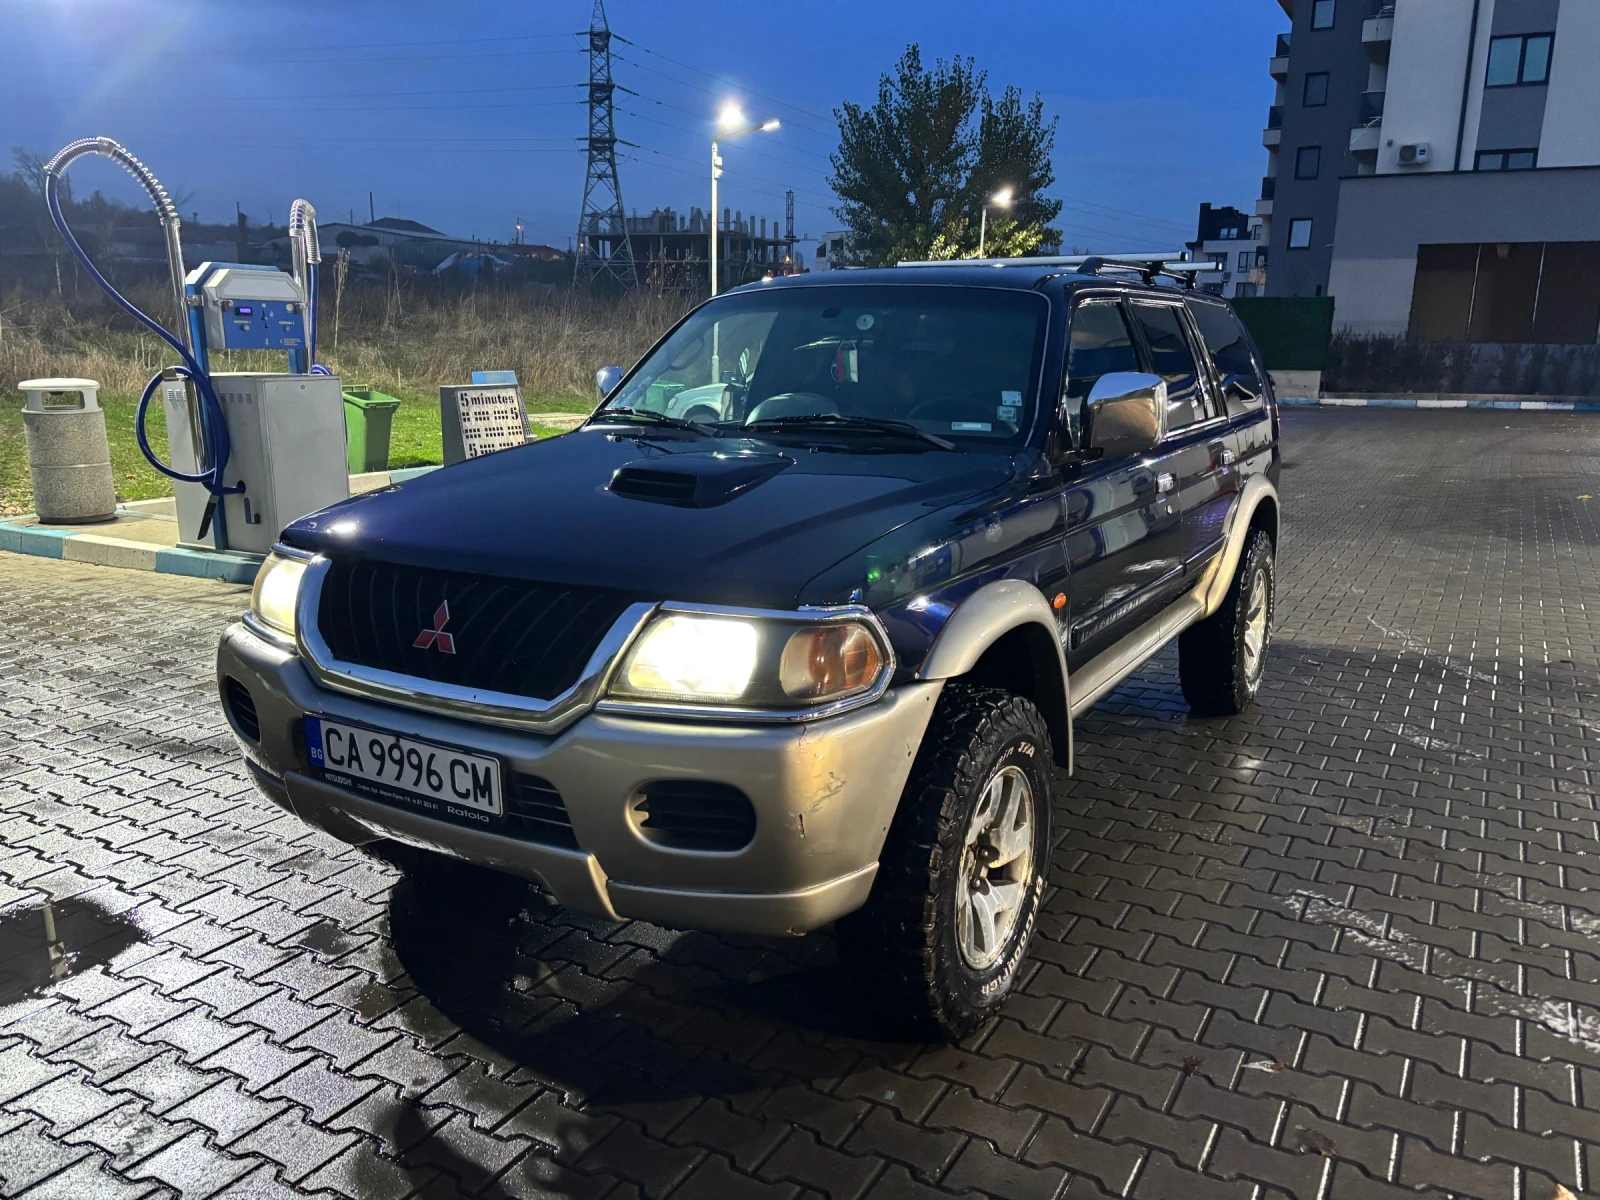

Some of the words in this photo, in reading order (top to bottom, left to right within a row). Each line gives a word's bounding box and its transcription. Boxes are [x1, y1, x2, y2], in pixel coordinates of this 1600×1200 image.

[460, 392, 470, 407] 5
[471, 393, 515, 405] minutes
[510, 407, 519, 421] 5
[468, 443, 478, 458] 5
[310, 747, 324, 761] BG
[325, 727, 365, 773] CA
[368, 739, 444, 792] 9996
[450, 759, 495, 807] CM
[324, 772, 353, 787] MITSUBISHI
[447, 805, 490, 823] Ratola
[981, 875, 1043, 997] BFGoodrich
